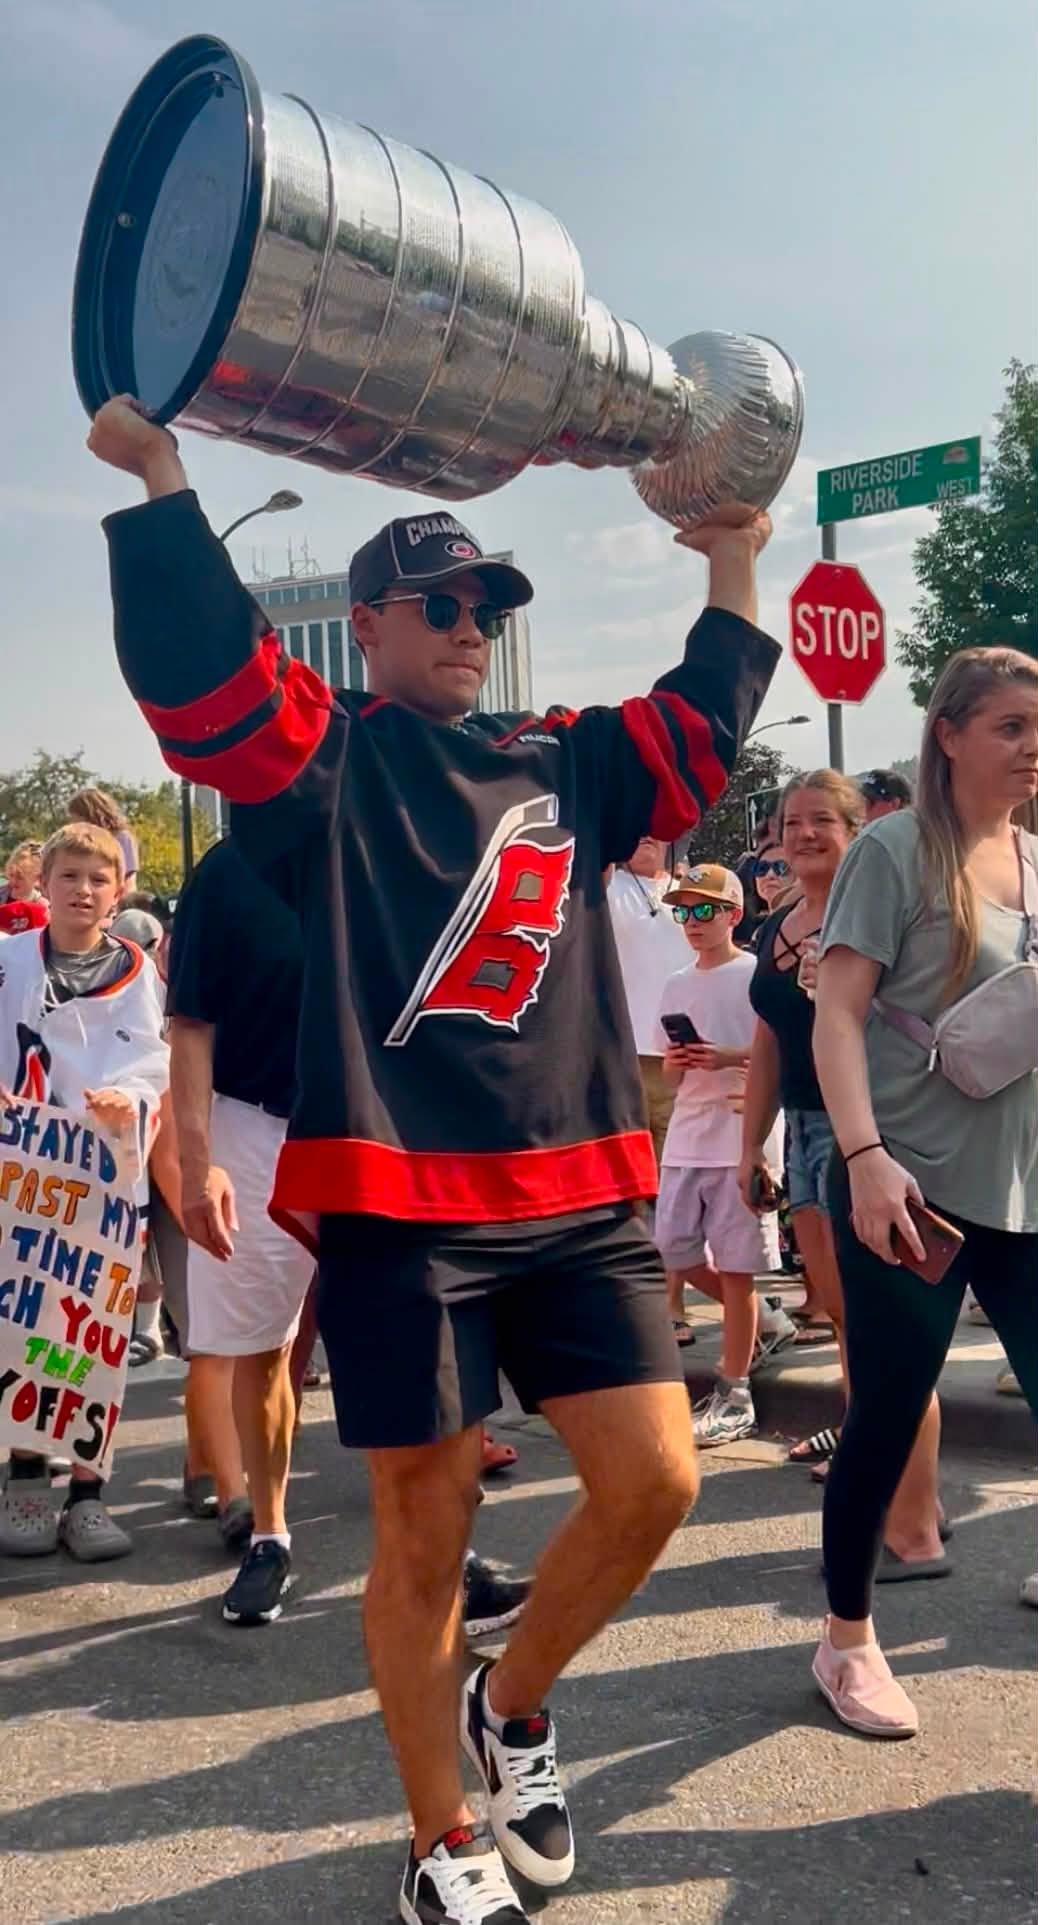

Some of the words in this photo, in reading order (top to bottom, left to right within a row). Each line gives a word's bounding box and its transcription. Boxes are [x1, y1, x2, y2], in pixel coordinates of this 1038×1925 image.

[831, 454, 924, 496] RIVERSIDE
[852, 486, 899, 514] PARK
[936, 477, 974, 498] WEST
[796, 603, 880, 661] STOP
[0, 1161, 91, 1225] PAST
[101, 1192, 137, 1249] MY
[11, 1225, 104, 1298] TIME
[60, 1296, 128, 1368] YOU
[25, 1336, 95, 1387] THE
